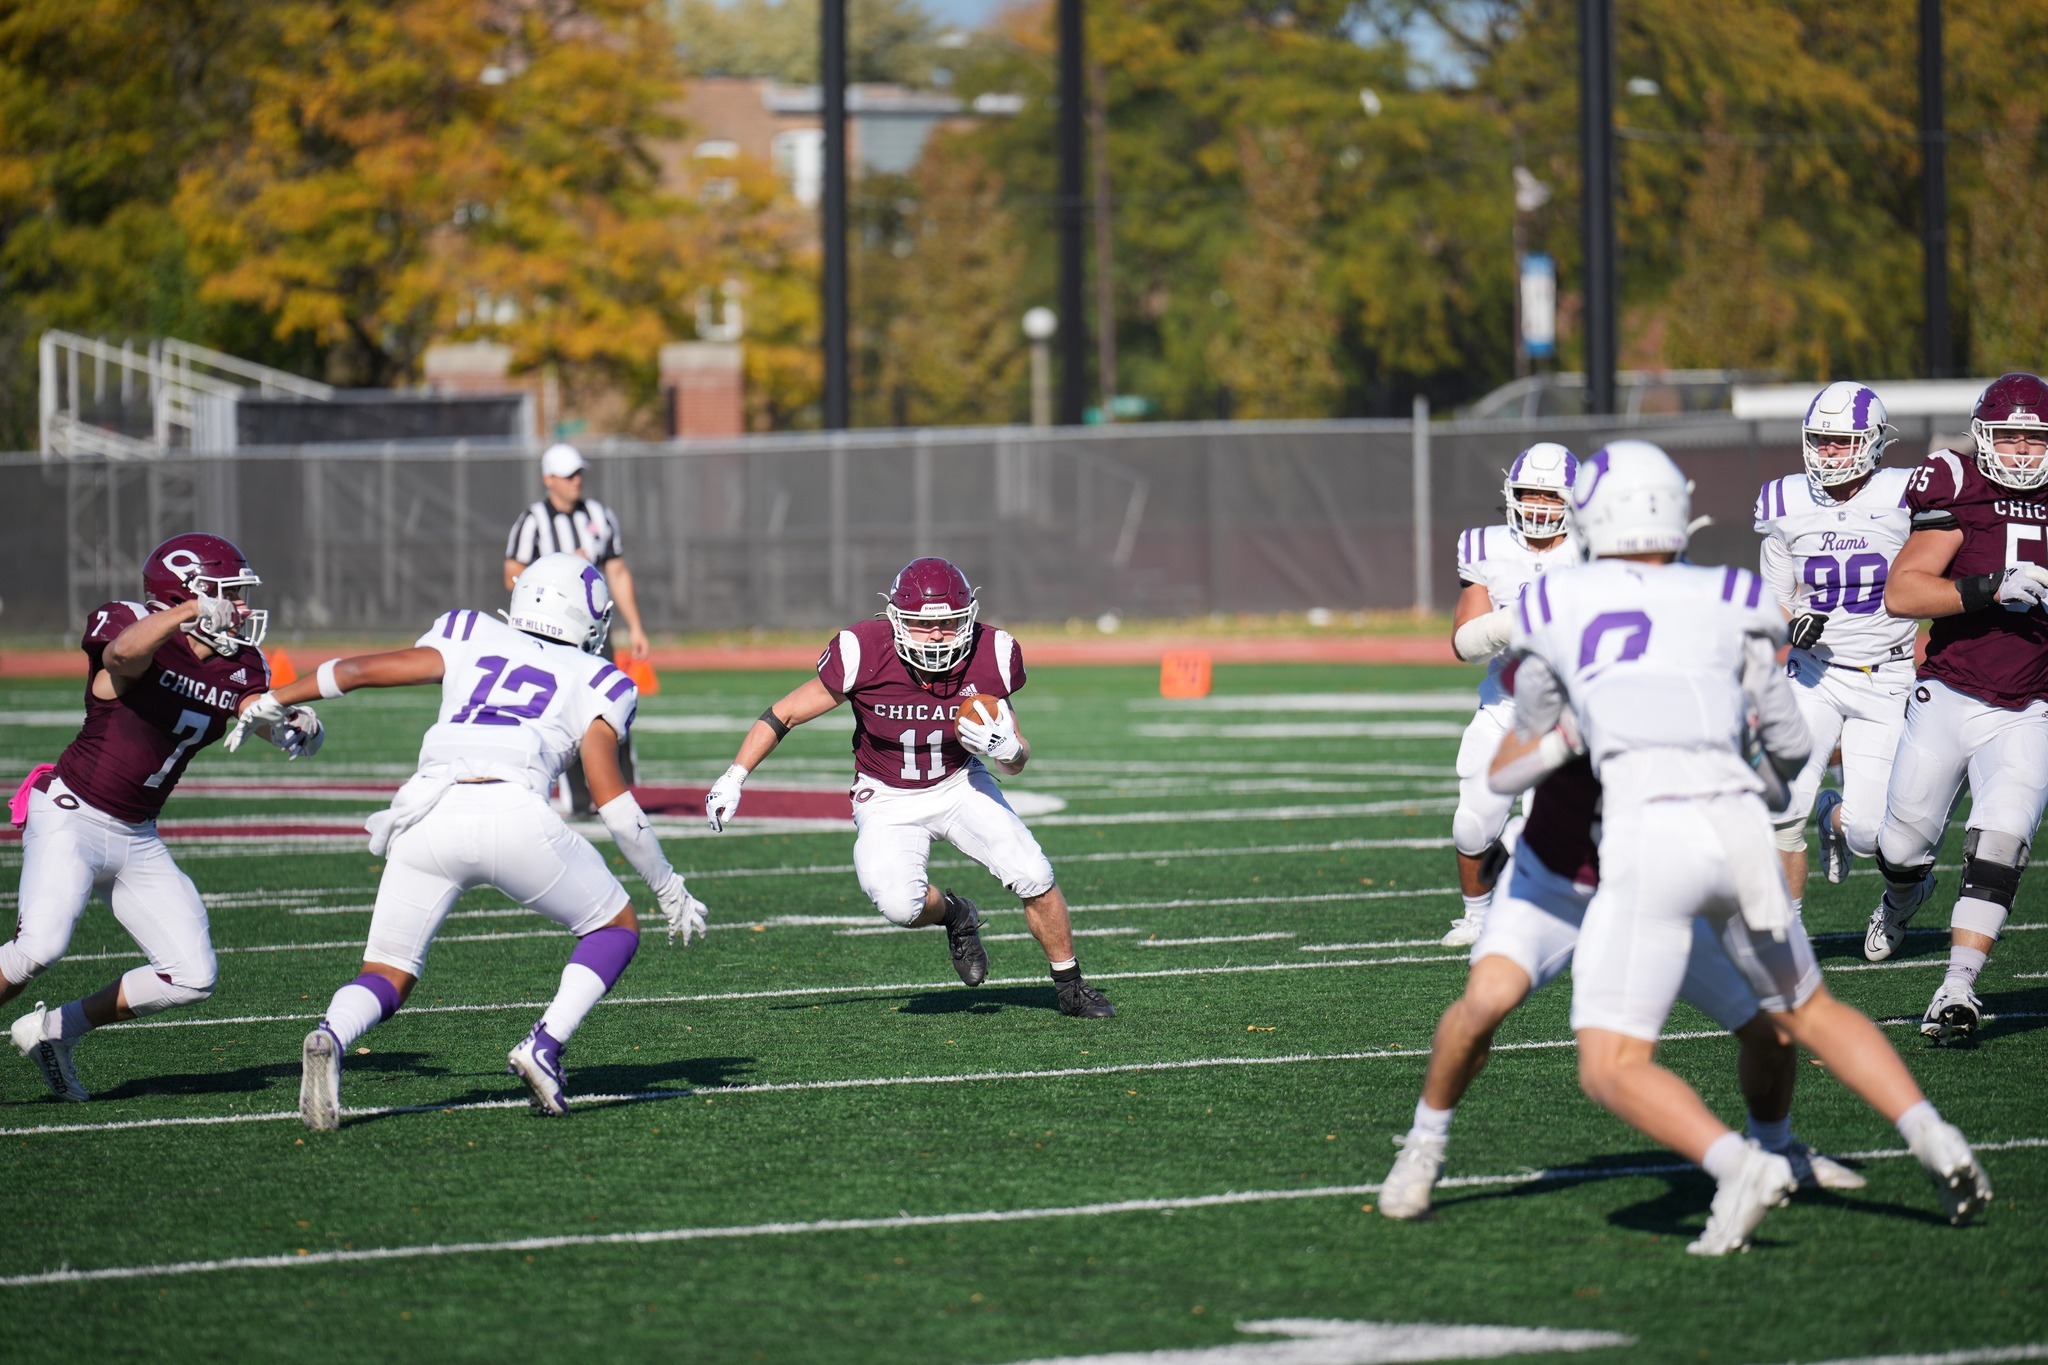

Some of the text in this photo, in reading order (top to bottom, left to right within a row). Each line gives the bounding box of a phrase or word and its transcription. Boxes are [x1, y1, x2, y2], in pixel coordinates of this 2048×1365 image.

[1819, 531, 1869, 551] Rams
[1804, 553, 1888, 614] 90
[91, 611, 108, 637] 7
[525, 619, 563, 637] HILLTOP
[159, 669, 240, 711] CHICAGO
[450, 655, 558, 727] 12
[143, 709, 211, 788] 7
[899, 729, 946, 780] 11
[987, 736, 1008, 753] adidas
